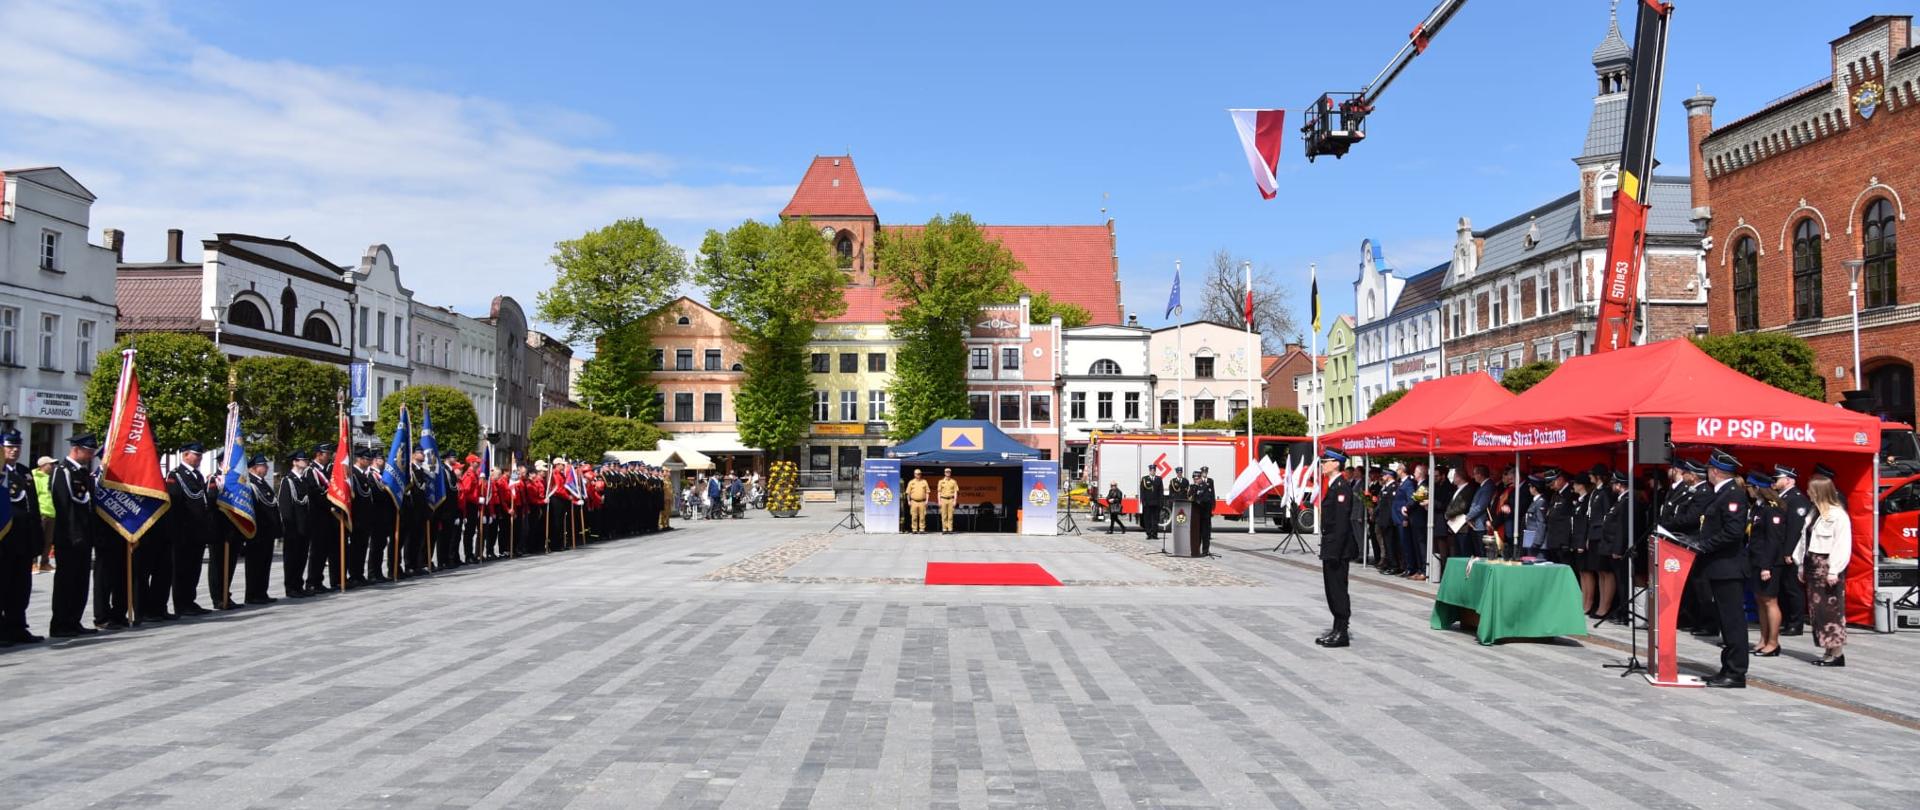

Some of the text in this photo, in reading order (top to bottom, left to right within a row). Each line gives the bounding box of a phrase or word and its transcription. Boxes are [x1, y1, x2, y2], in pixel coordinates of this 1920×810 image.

[1513, 429, 1533, 447] Straż
[1534, 427, 1567, 445] Pożarna
[1697, 417, 1817, 443] KP PSP Puck
